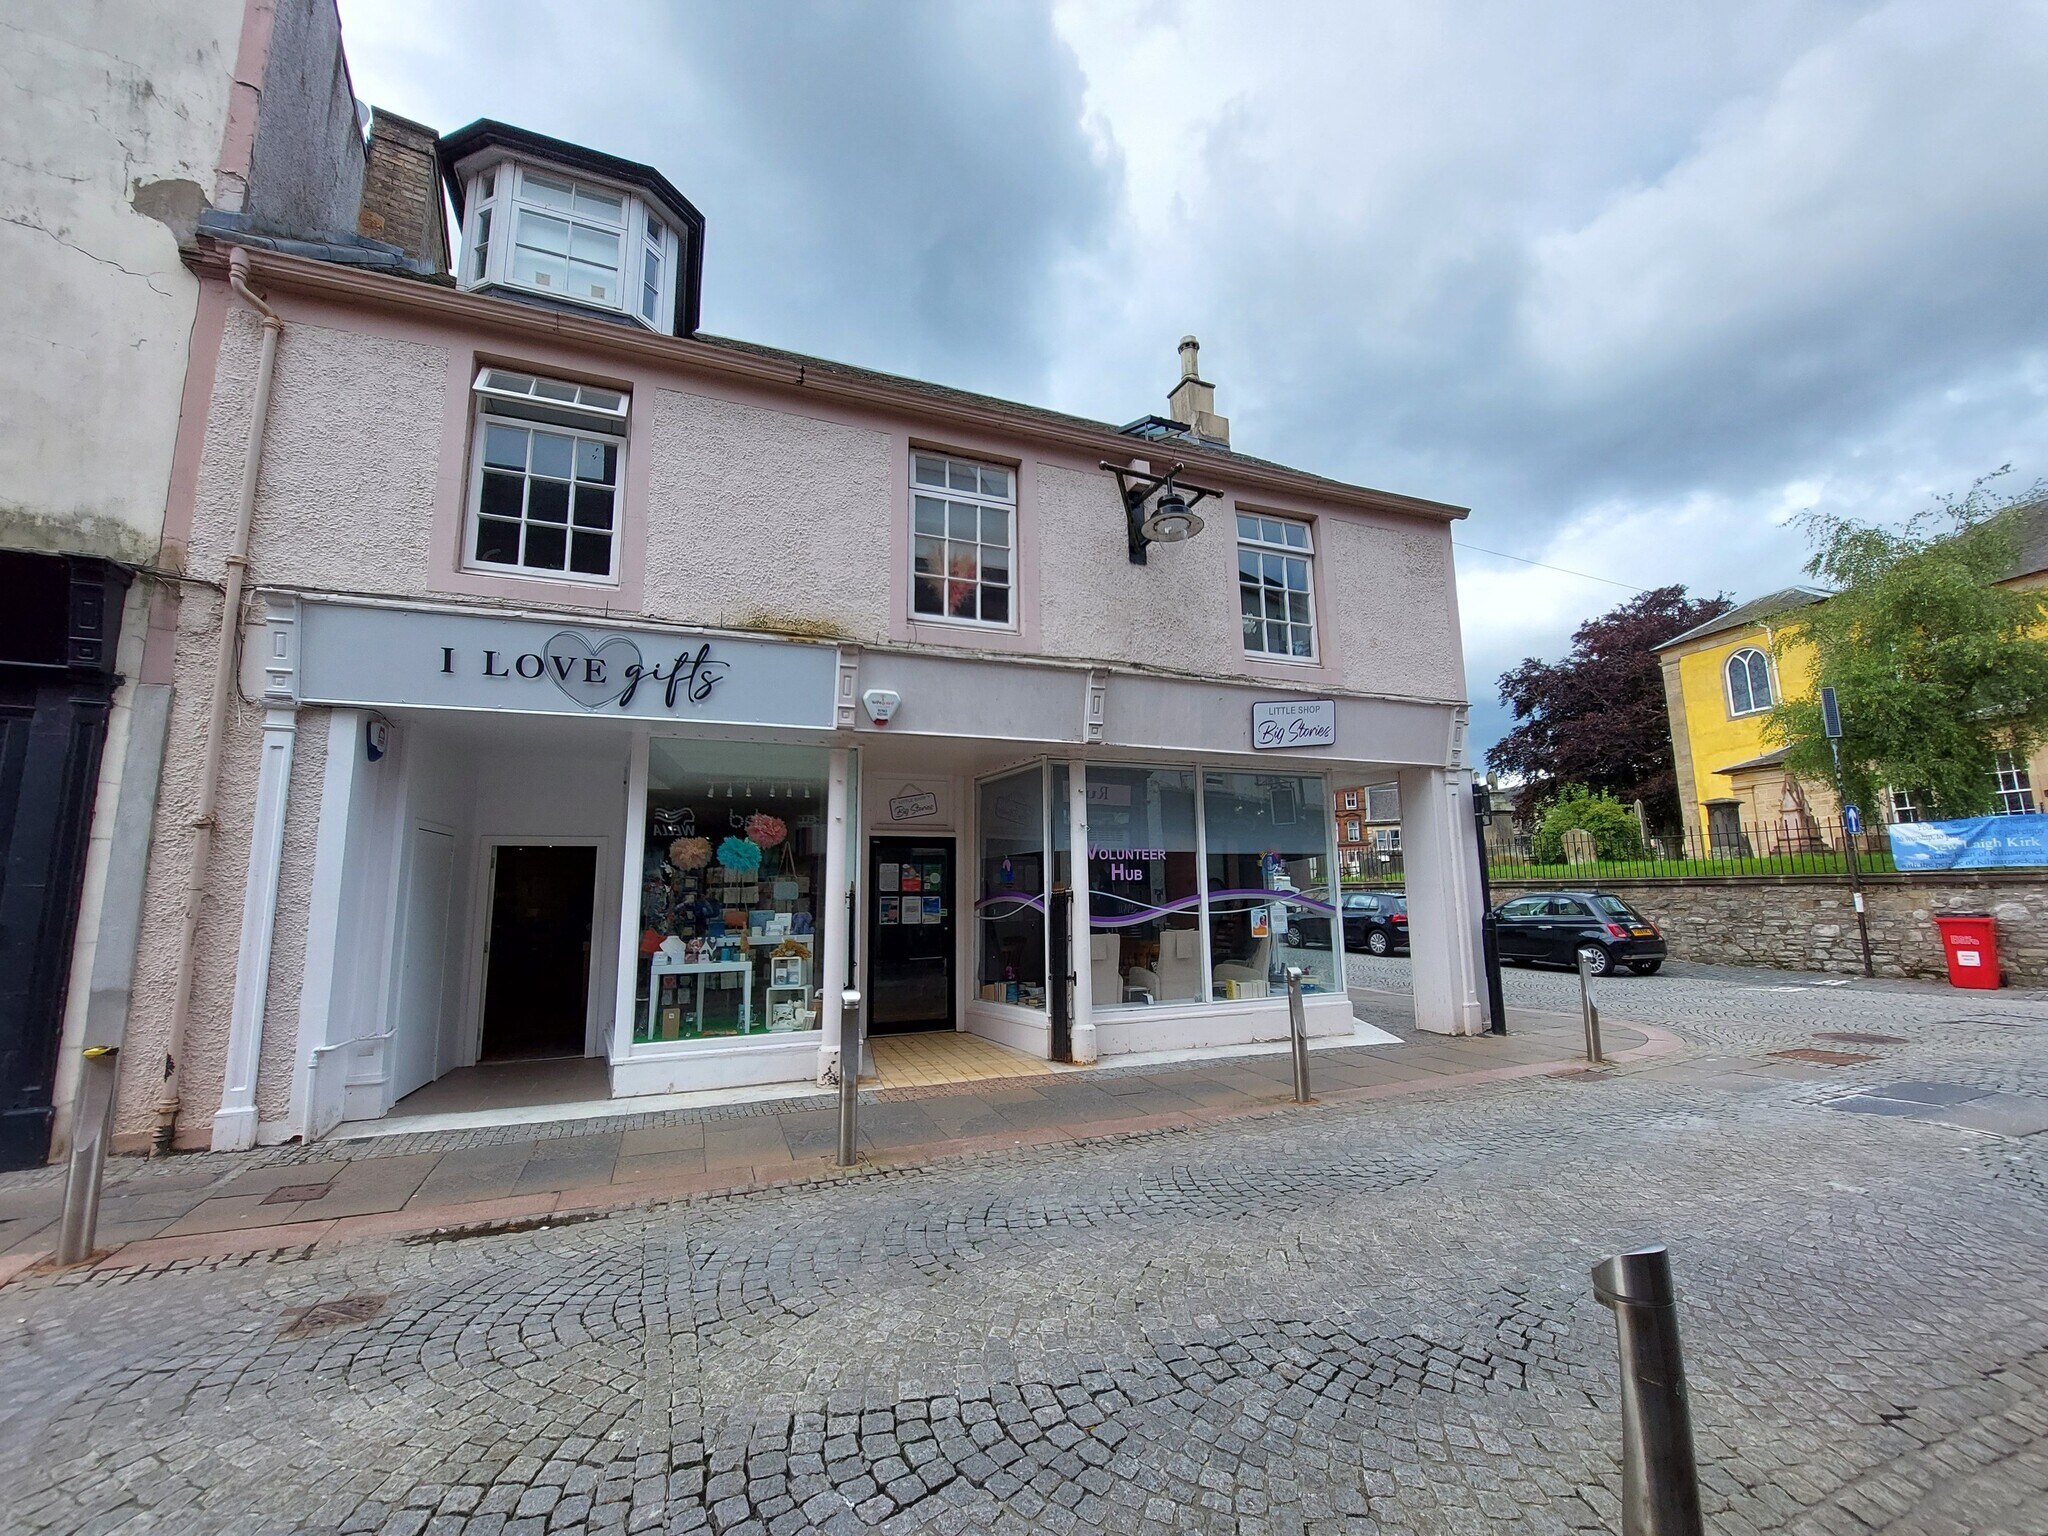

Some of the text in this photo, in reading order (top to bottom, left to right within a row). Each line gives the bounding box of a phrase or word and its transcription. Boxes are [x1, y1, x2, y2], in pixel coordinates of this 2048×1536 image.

[440, 643, 731, 708] I LOVE gifts
[1268, 705, 1321, 716] LITTLE SHOP
[1258, 718, 1332, 745] Big Stories
[1963, 837, 2002, 850] Laigh
[2007, 837, 2041, 848] Kirk
[1088, 844, 1166, 860] VOLUNTEER
